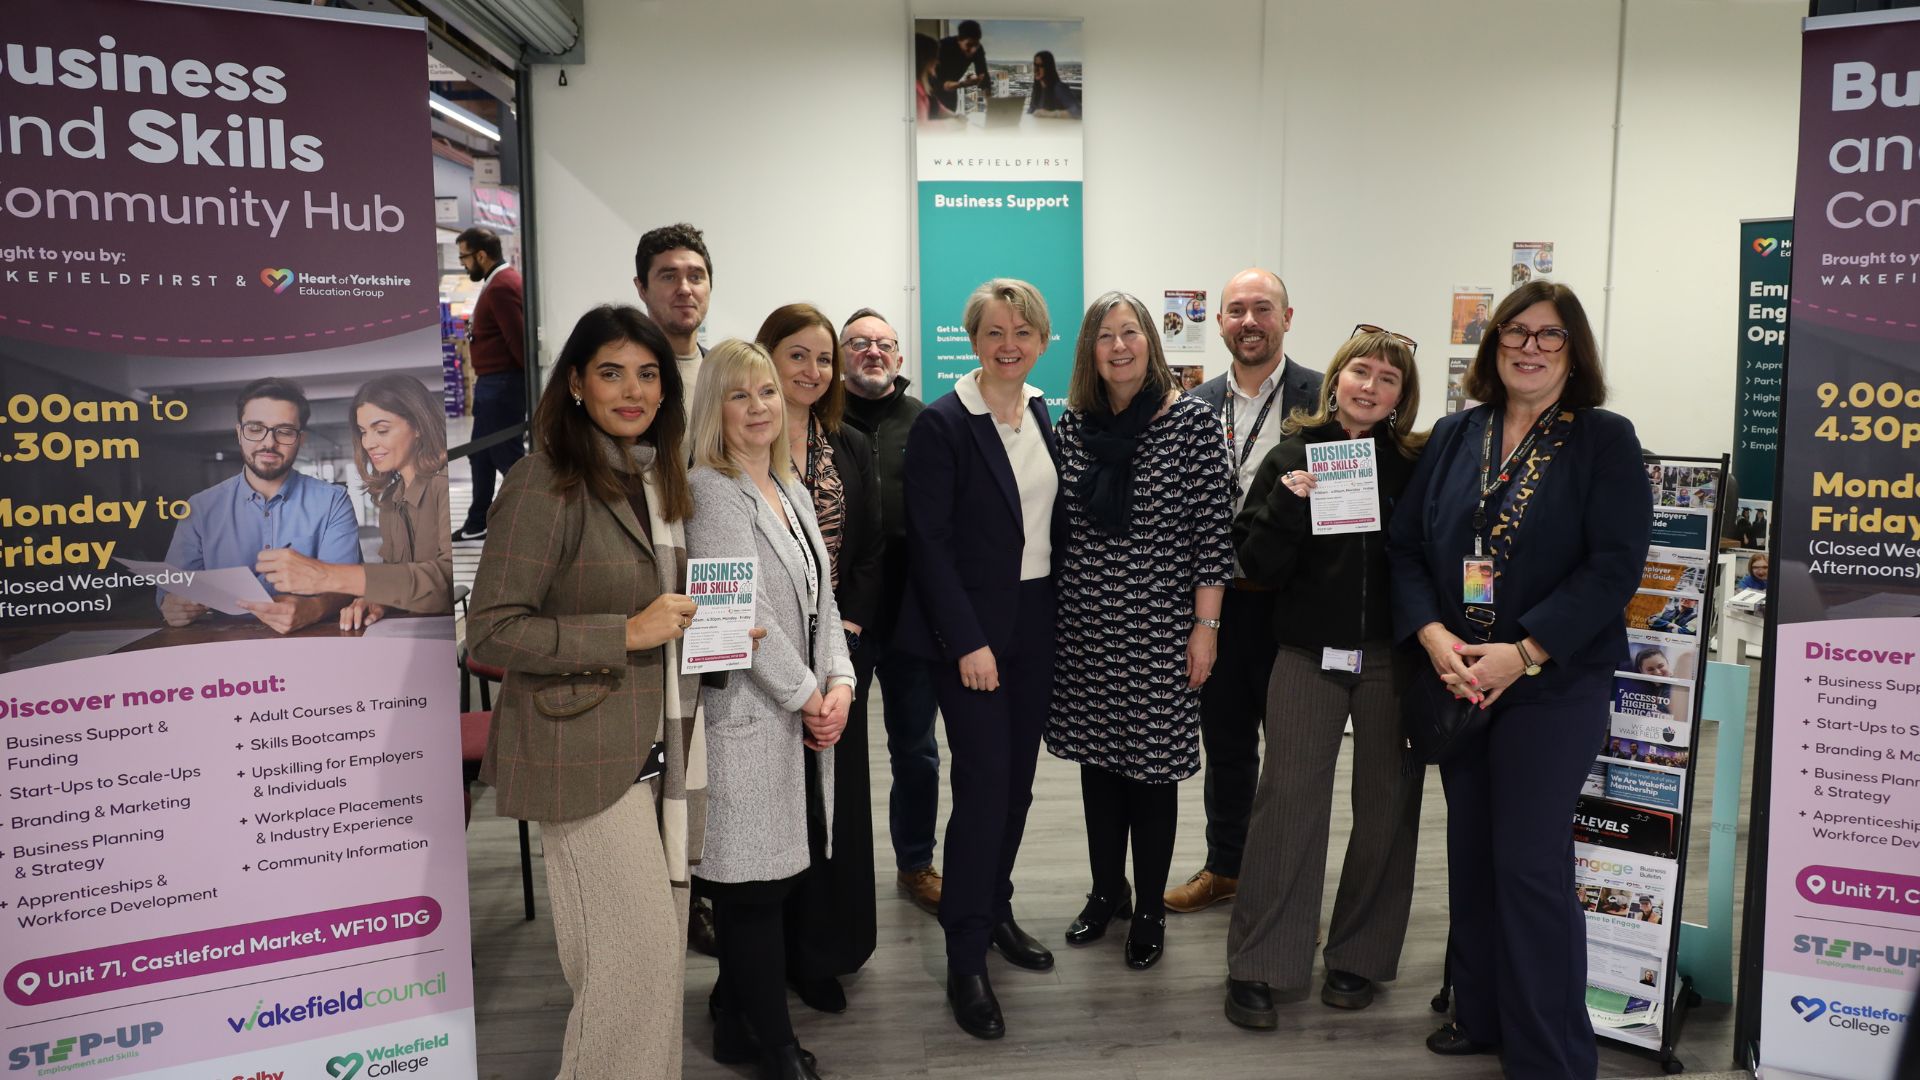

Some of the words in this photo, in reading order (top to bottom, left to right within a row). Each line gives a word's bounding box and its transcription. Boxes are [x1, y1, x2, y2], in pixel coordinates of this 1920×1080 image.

[0, 35, 288, 104] usiness
[0, 106, 106, 159] nd
[128, 109, 324, 172] Skills
[934, 159, 1070, 167] WAKEFIELDFIRST
[1829, 134, 1920, 174] an
[0, 182, 290, 238] ommunity
[304, 190, 405, 233] Hub
[935, 194, 1003, 208] Business
[1007, 194, 1069, 211] Support
[0, 246, 36, 264] ght
[39, 248, 58, 261] to
[62, 251, 95, 264] you
[100, 248, 126, 264] by:
[1822, 252, 1886, 266] Brought
[1890, 253, 1905, 264] to
[7, 270, 218, 287] KEFIELDFIRST
[236, 275, 247, 287] &
[299, 273, 337, 284] Heart
[350, 274, 411, 286] Yorkshire
[1821, 273, 1916, 286] WAKEFI
[299, 287, 351, 297] Education
[353, 289, 385, 298] Group
[1753, 393, 1780, 403] Highe
[1816, 382, 1920, 409] 9.00a
[0, 393, 139, 422] .00am
[150, 395, 188, 421] to
[1814, 415, 1920, 449] 4.30p
[0, 432, 140, 468] .30pm
[1310, 442, 1371, 463] BUSINESS
[1312, 461, 1329, 473] AND
[1331, 459, 1358, 471] SKILLS
[1358, 468, 1373, 478] HUB
[1813, 471, 1920, 499] Mond
[156, 496, 192, 520] to
[0, 536, 116, 569] riday
[1809, 540, 1880, 557] (Closed
[691, 562, 753, 582] BUSINESS
[1652, 573, 1676, 581] Guide
[1809, 560, 1920, 578] Afternoons)
[68, 568, 196, 592] Wednesday
[690, 582, 708, 594] AND
[710, 581, 738, 594] SKILLS
[0, 594, 113, 618] fternoons)
[738, 593, 752, 604] HUB
[1805, 642, 1916, 665] Discover
[123, 686, 195, 708] more
[201, 674, 286, 700] about:
[1818, 675, 1882, 690] Business
[249, 708, 290, 724] Adult
[292, 703, 353, 720] Courses
[356, 700, 366, 712] &
[370, 694, 427, 711] Training
[1621, 700, 1658, 712] HIGHER
[1622, 692, 1656, 703] ACCESS
[1659, 697, 1671, 705] TO
[1817, 693, 1877, 709] Funding
[7, 731, 82, 750] Business
[86, 721, 154, 743] Support
[157, 720, 168, 733] &
[1619, 728, 1660, 740] WAKEFIELD
[1816, 718, 1887, 735] Start-Ups
[1891, 725, 1906, 735] to
[250, 735, 288, 752] Skills
[291, 728, 376, 746] Bootcamps
[7, 752, 79, 771] Funding
[1815, 743, 1882, 761] Branding
[1886, 748, 1896, 760] &
[252, 760, 322, 781] Upskilling
[326, 757, 346, 771] for
[350, 748, 424, 769] Employers
[9, 778, 94, 800] Start-Ups
[97, 776, 114, 789] to
[117, 766, 201, 787] Scale-Ups
[1623, 777, 1638, 785] Are
[1639, 779, 1677, 792] Wakefield
[1814, 768, 1878, 784] Business
[254, 785, 264, 798] &
[267, 776, 347, 796] Individuals
[1610, 782, 1659, 796] Membership
[1814, 785, 1824, 796] &
[1828, 786, 1891, 805] Strategy
[11, 806, 90, 829] Branding
[94, 804, 105, 818] &
[110, 795, 191, 816] Marketing
[255, 805, 336, 826] Workplace
[339, 794, 423, 814] Placements
[256, 832, 266, 844] &
[270, 824, 330, 844] Industry
[333, 815, 413, 835] Experience
[1813, 827, 1888, 845] Workforce
[13, 837, 90, 859] Business
[92, 826, 165, 849] Planning
[257, 850, 343, 872] Community
[346, 838, 428, 858] Information
[15, 866, 27, 879] &
[31, 855, 105, 877] Strategy
[1640, 866, 1666, 875] Business
[1640, 872, 1662, 881] Bulletin
[16, 879, 153, 910] Apprenticeships
[156, 874, 168, 886] &
[1831, 880, 1871, 898] Unit
[1876, 885, 1900, 904] 71,
[18, 904, 106, 929] Workforce
[110, 886, 218, 914] Development
[1611, 918, 1640, 929] Engage
[48, 966, 94, 988] Unit
[100, 961, 127, 981] 71,
[131, 942, 245, 974] Castleford
[250, 926, 327, 954] Market,
[330, 915, 387, 938] WF10
[391, 908, 430, 929] 1DG
[1816, 959, 1865, 971] Employment
[1867, 966, 1882, 974] and
[1883, 967, 1905, 976] Skills
[1830, 1001, 1910, 1023] Castlefor
[1829, 1015, 1890, 1036] College
[366, 1033, 449, 1063] Wakefield
[38, 1060, 96, 1077] Employment
[97, 1055, 114, 1065] and
[115, 1050, 139, 1062] Skills
[367, 1054, 429, 1079] College
